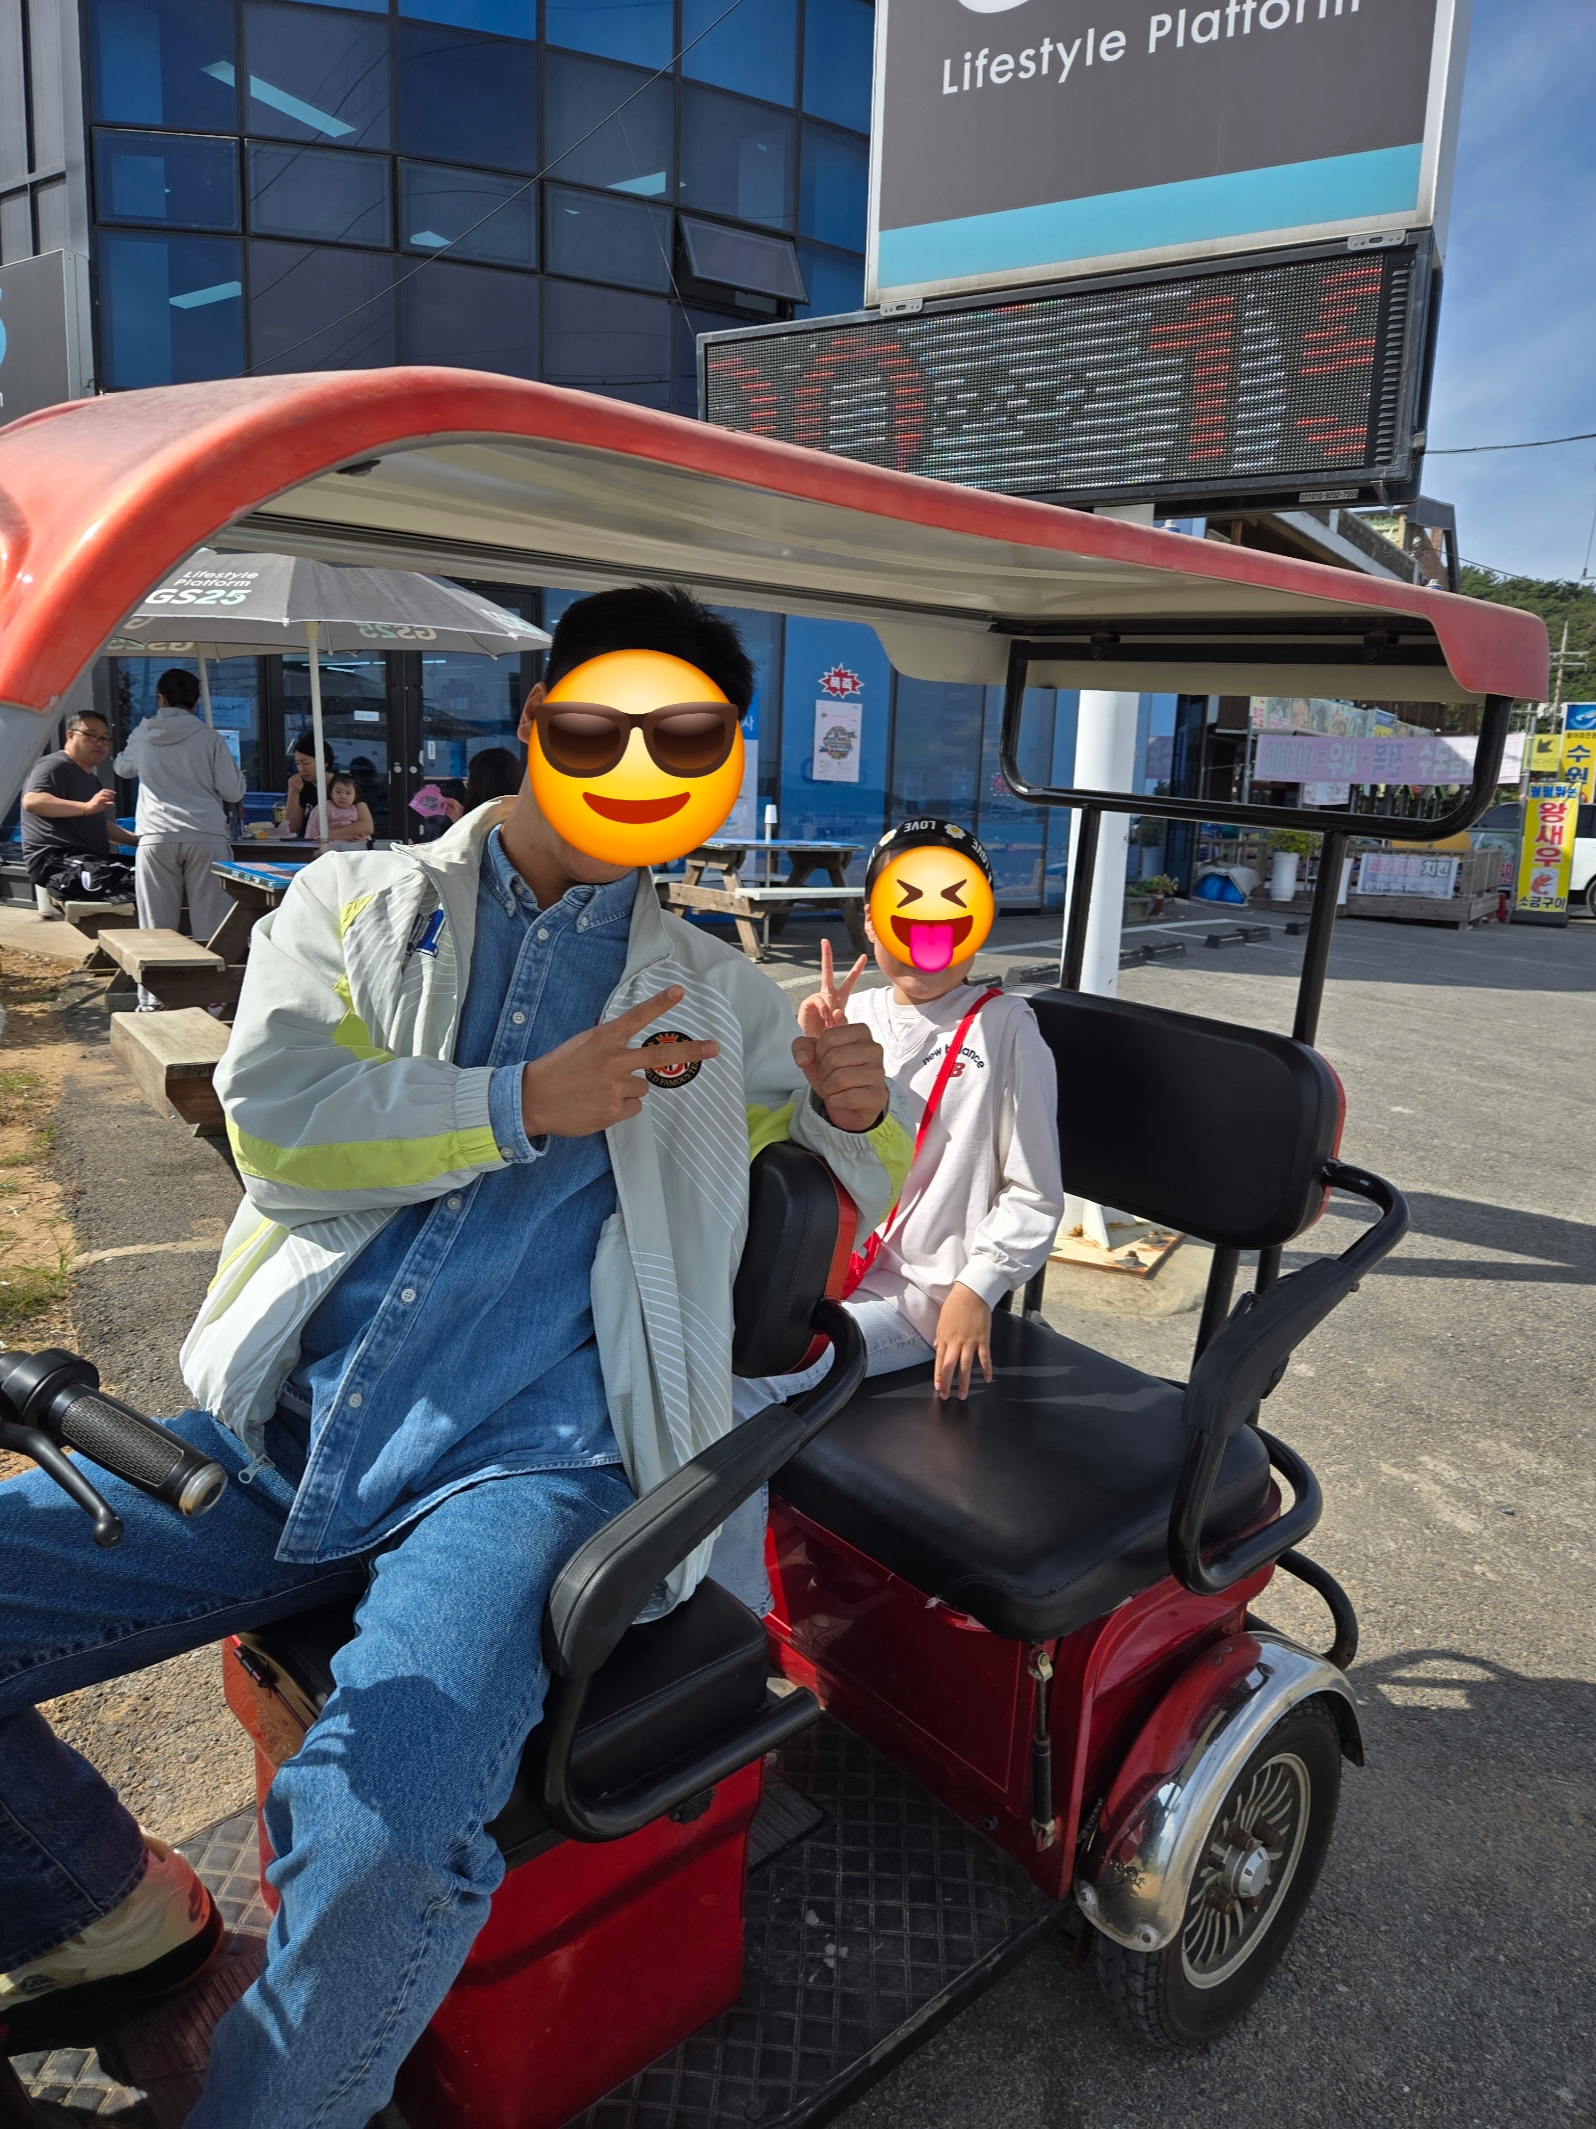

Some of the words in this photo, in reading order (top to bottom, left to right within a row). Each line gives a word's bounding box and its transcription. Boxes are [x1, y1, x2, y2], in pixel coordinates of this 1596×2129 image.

[942, 28, 1127, 94] Lifestyle
[173, 578, 252, 587] Platform
[183, 570, 259, 580] Lifestyle
[144, 588, 253, 606] GS25
[903, 820, 936, 833] LOVE
[1534, 802, 1568, 868] 왕새우
[1422, 860, 1450, 878] 치킨
[1518, 896, 1566, 909] 소금구이
[922, 1047, 942, 1066] new
[944, 1043, 985, 1069] blance
[659, 1073, 692, 1087] FAMOUS
